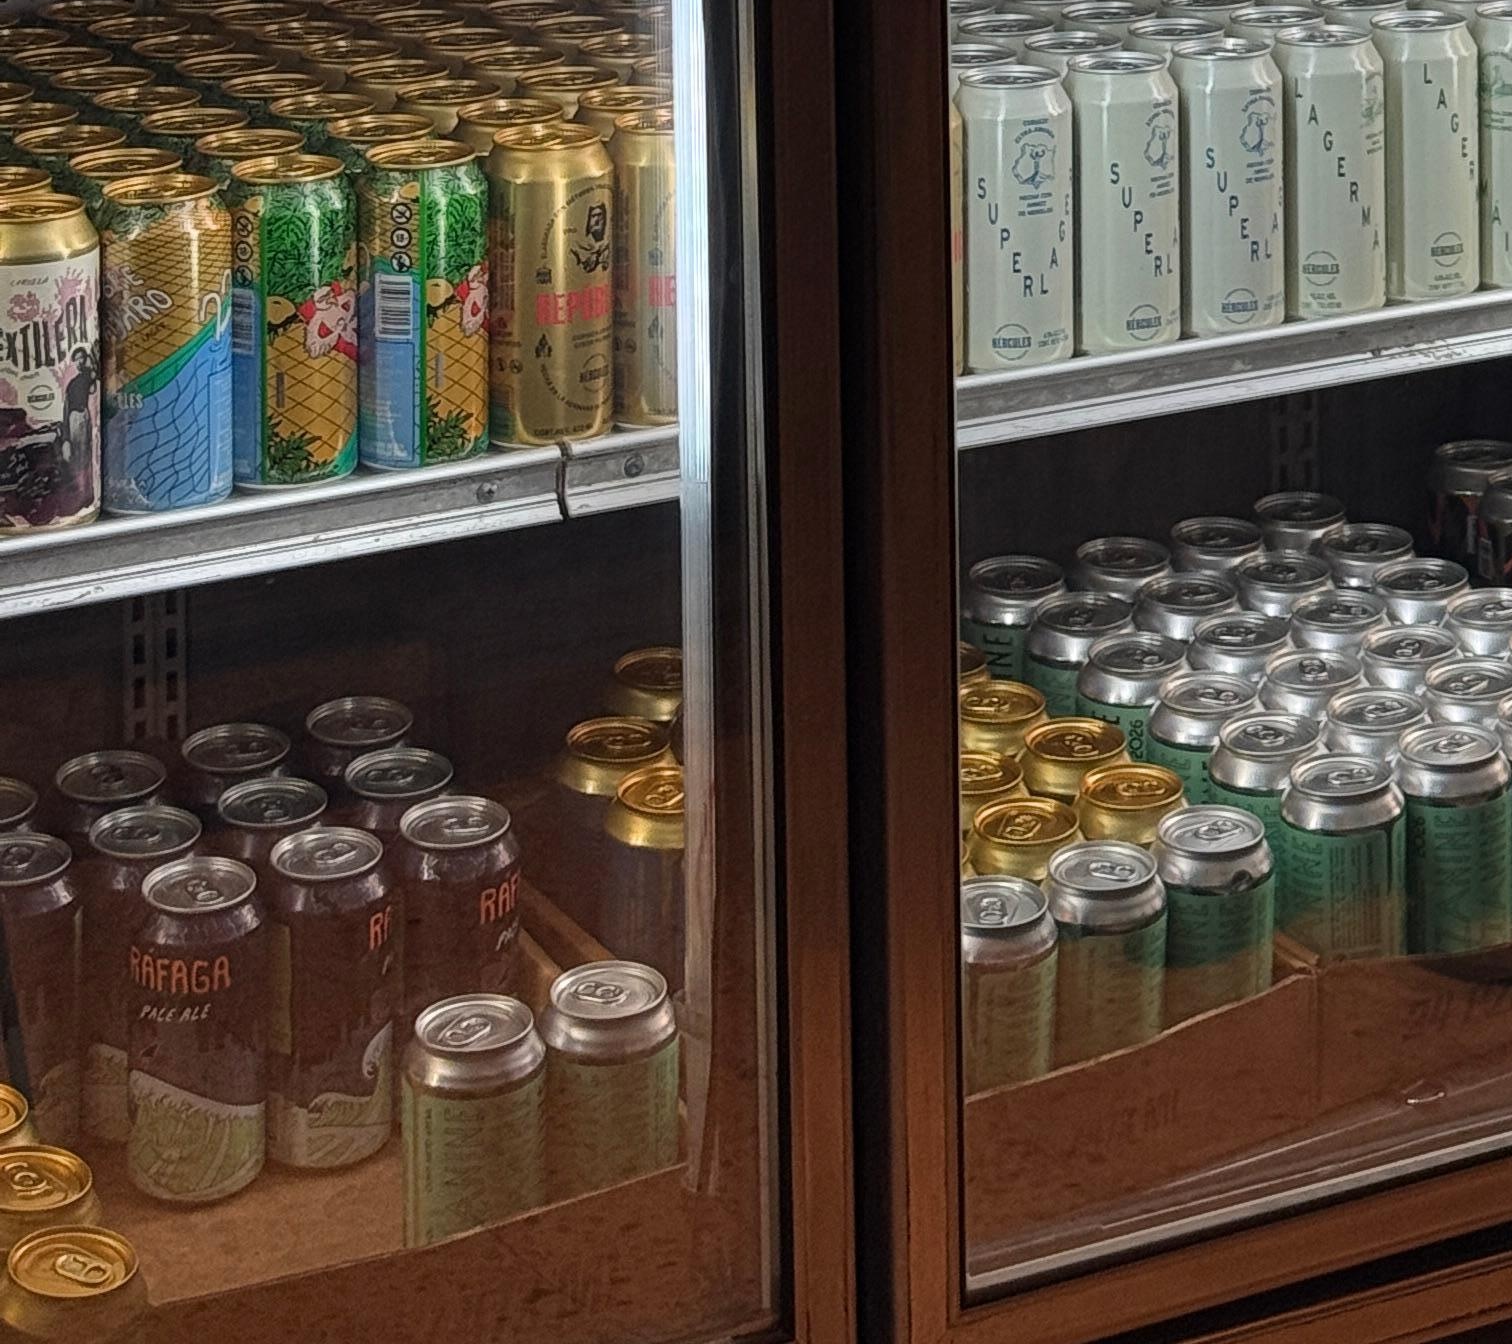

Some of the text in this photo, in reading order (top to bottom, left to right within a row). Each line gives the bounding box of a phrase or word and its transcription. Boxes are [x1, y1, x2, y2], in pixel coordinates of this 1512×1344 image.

[1295, 78, 1360, 203] LAGER
[977, 177, 1034, 298] SUPER
[1109, 162, 1164, 278] SUPER
[1205, 147, 1260, 262] SUPER
[1128, 719, 1144, 759] 2026
[129, 944, 233, 995] RÁFAGA
